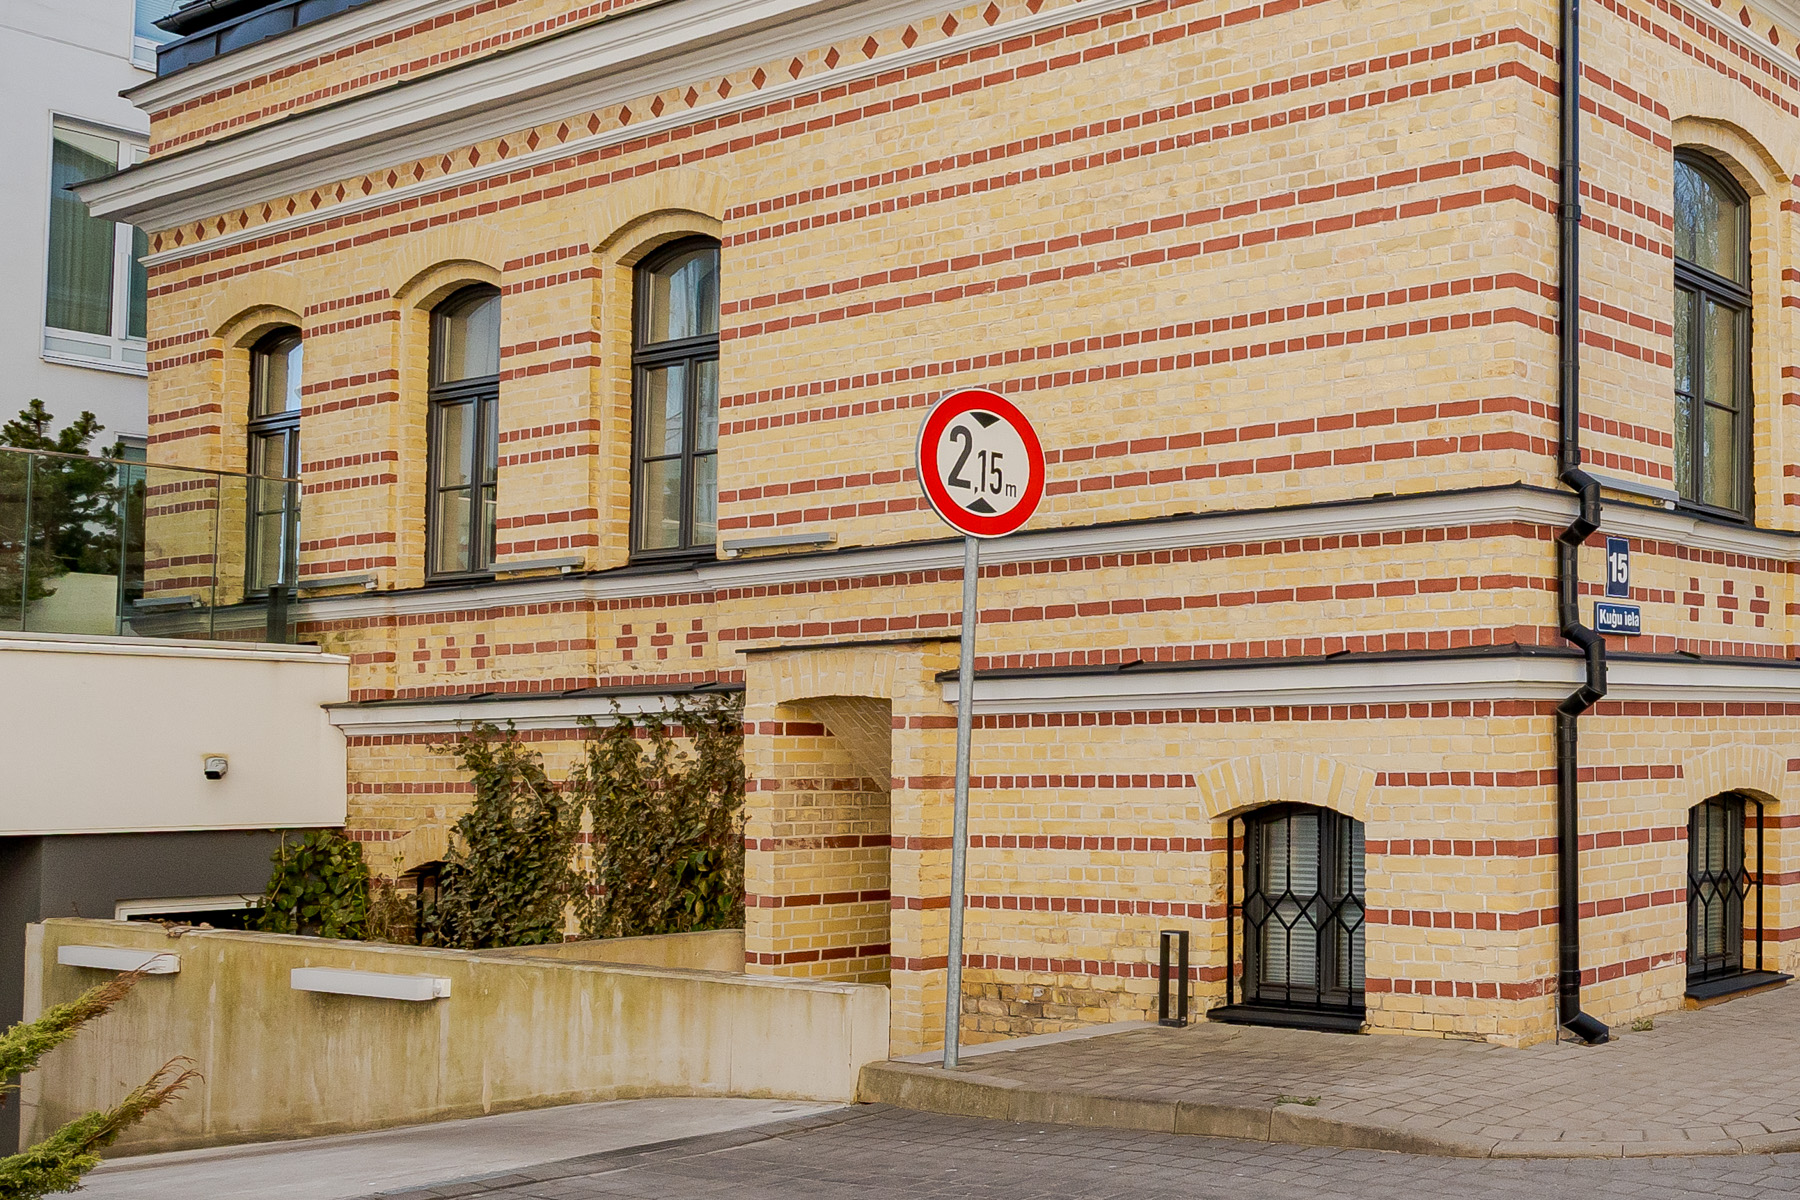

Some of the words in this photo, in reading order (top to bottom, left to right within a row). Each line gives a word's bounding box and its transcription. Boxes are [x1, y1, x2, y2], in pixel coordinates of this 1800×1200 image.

[1609, 552, 1628, 584] 15
[1600, 608, 1623, 628] Kuģu
[1624, 611, 1640, 627] iela
